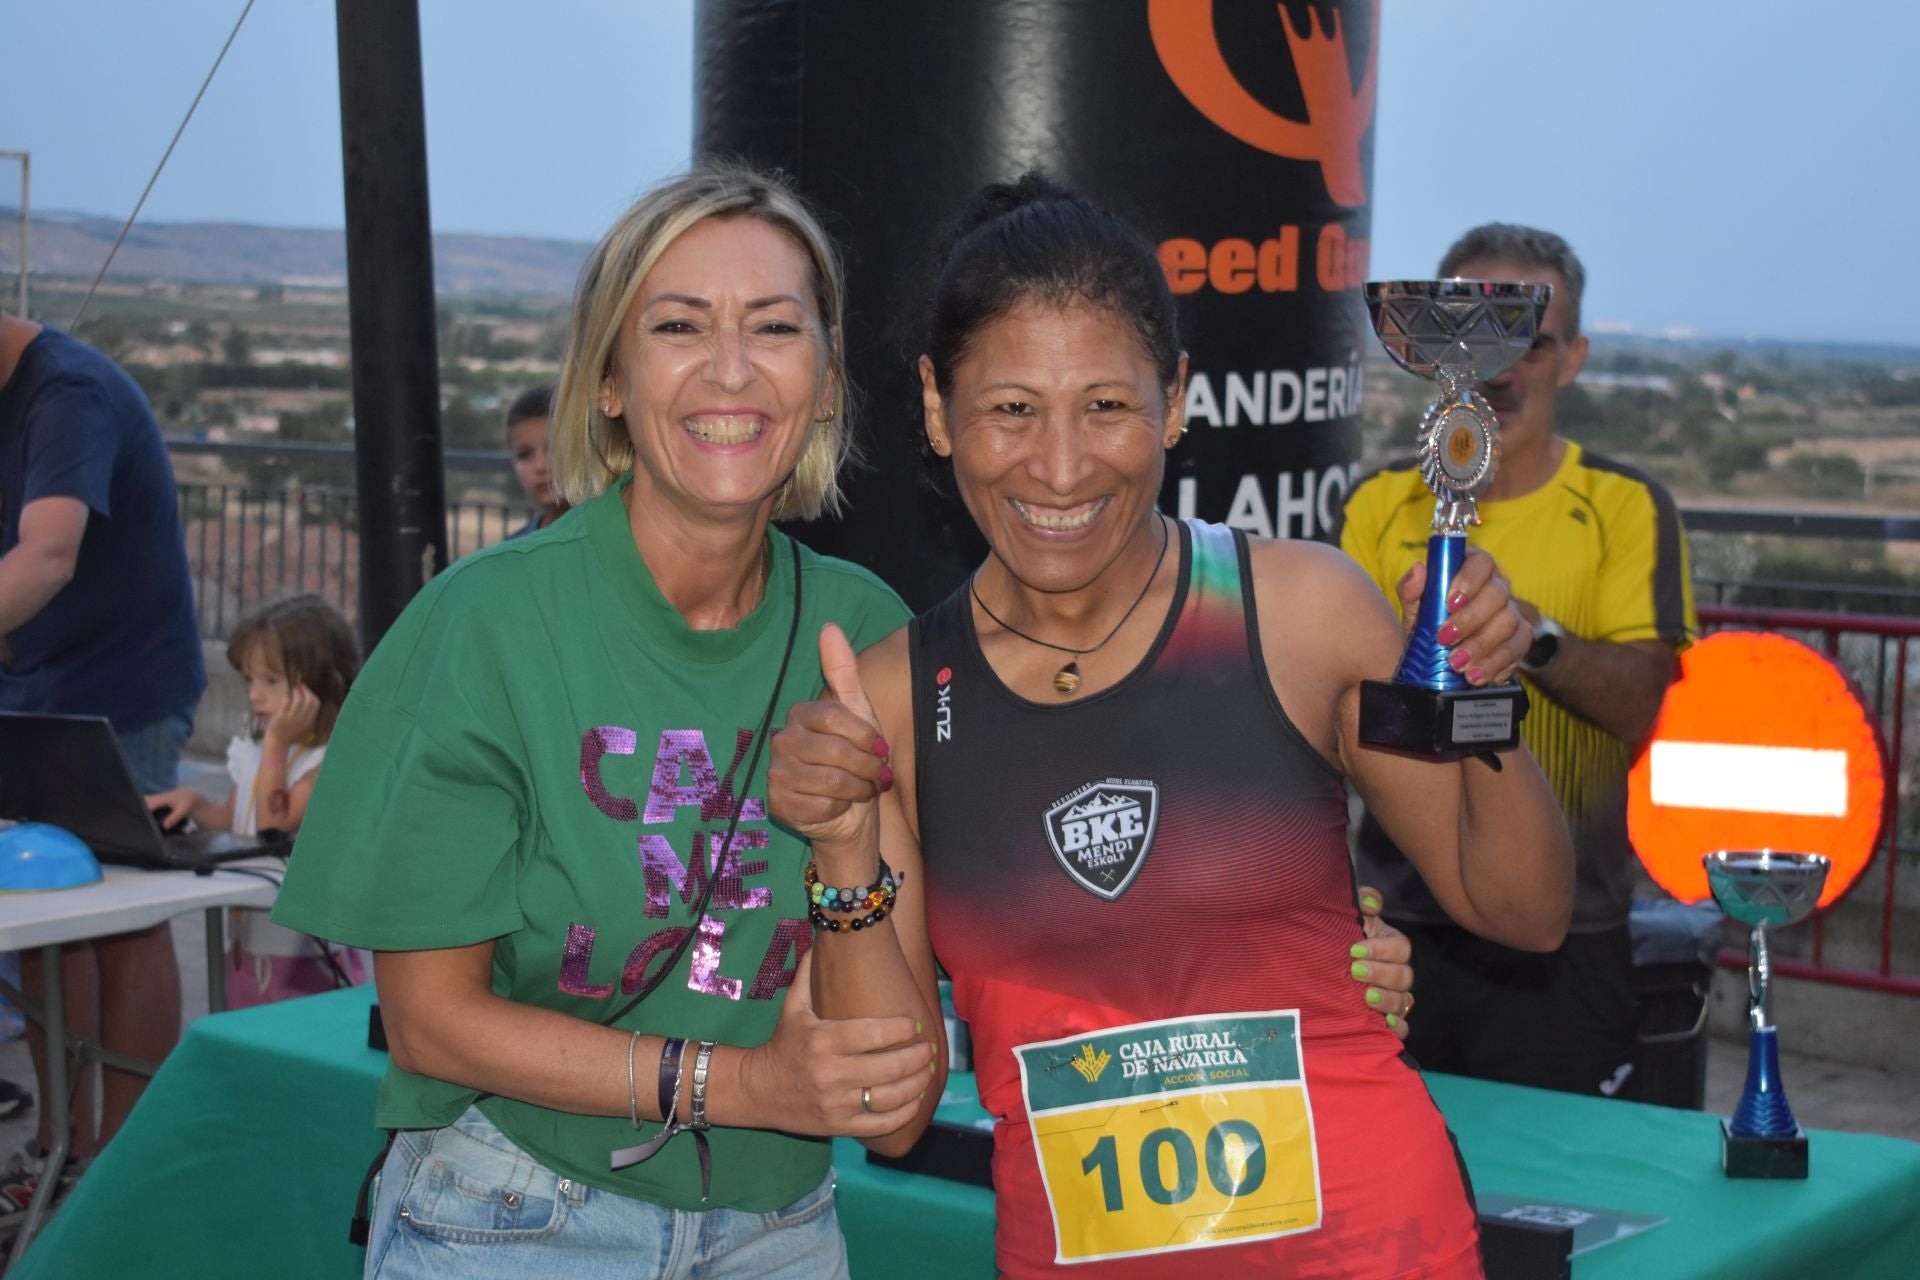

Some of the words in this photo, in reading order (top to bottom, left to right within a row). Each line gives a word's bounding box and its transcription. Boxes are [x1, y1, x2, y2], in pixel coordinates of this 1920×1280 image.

[579, 724, 780, 824] CAL
[1061, 806, 1145, 855] BKE
[1077, 838, 1134, 862] MENDI
[637, 830, 772, 919] ME
[1086, 852, 1126, 869] ESKOLA
[557, 914, 813, 1001] LOLA
[1119, 1038, 1167, 1061] CAJA
[1168, 1031, 1237, 1054] RURAL
[1121, 1058, 1149, 1078] DE
[1152, 1048, 1248, 1074] NAVARRA
[1164, 1072, 1205, 1085] ACCIÓN
[1209, 1068, 1250, 1080] SOCIAL
[1081, 1119, 1267, 1213] 100
